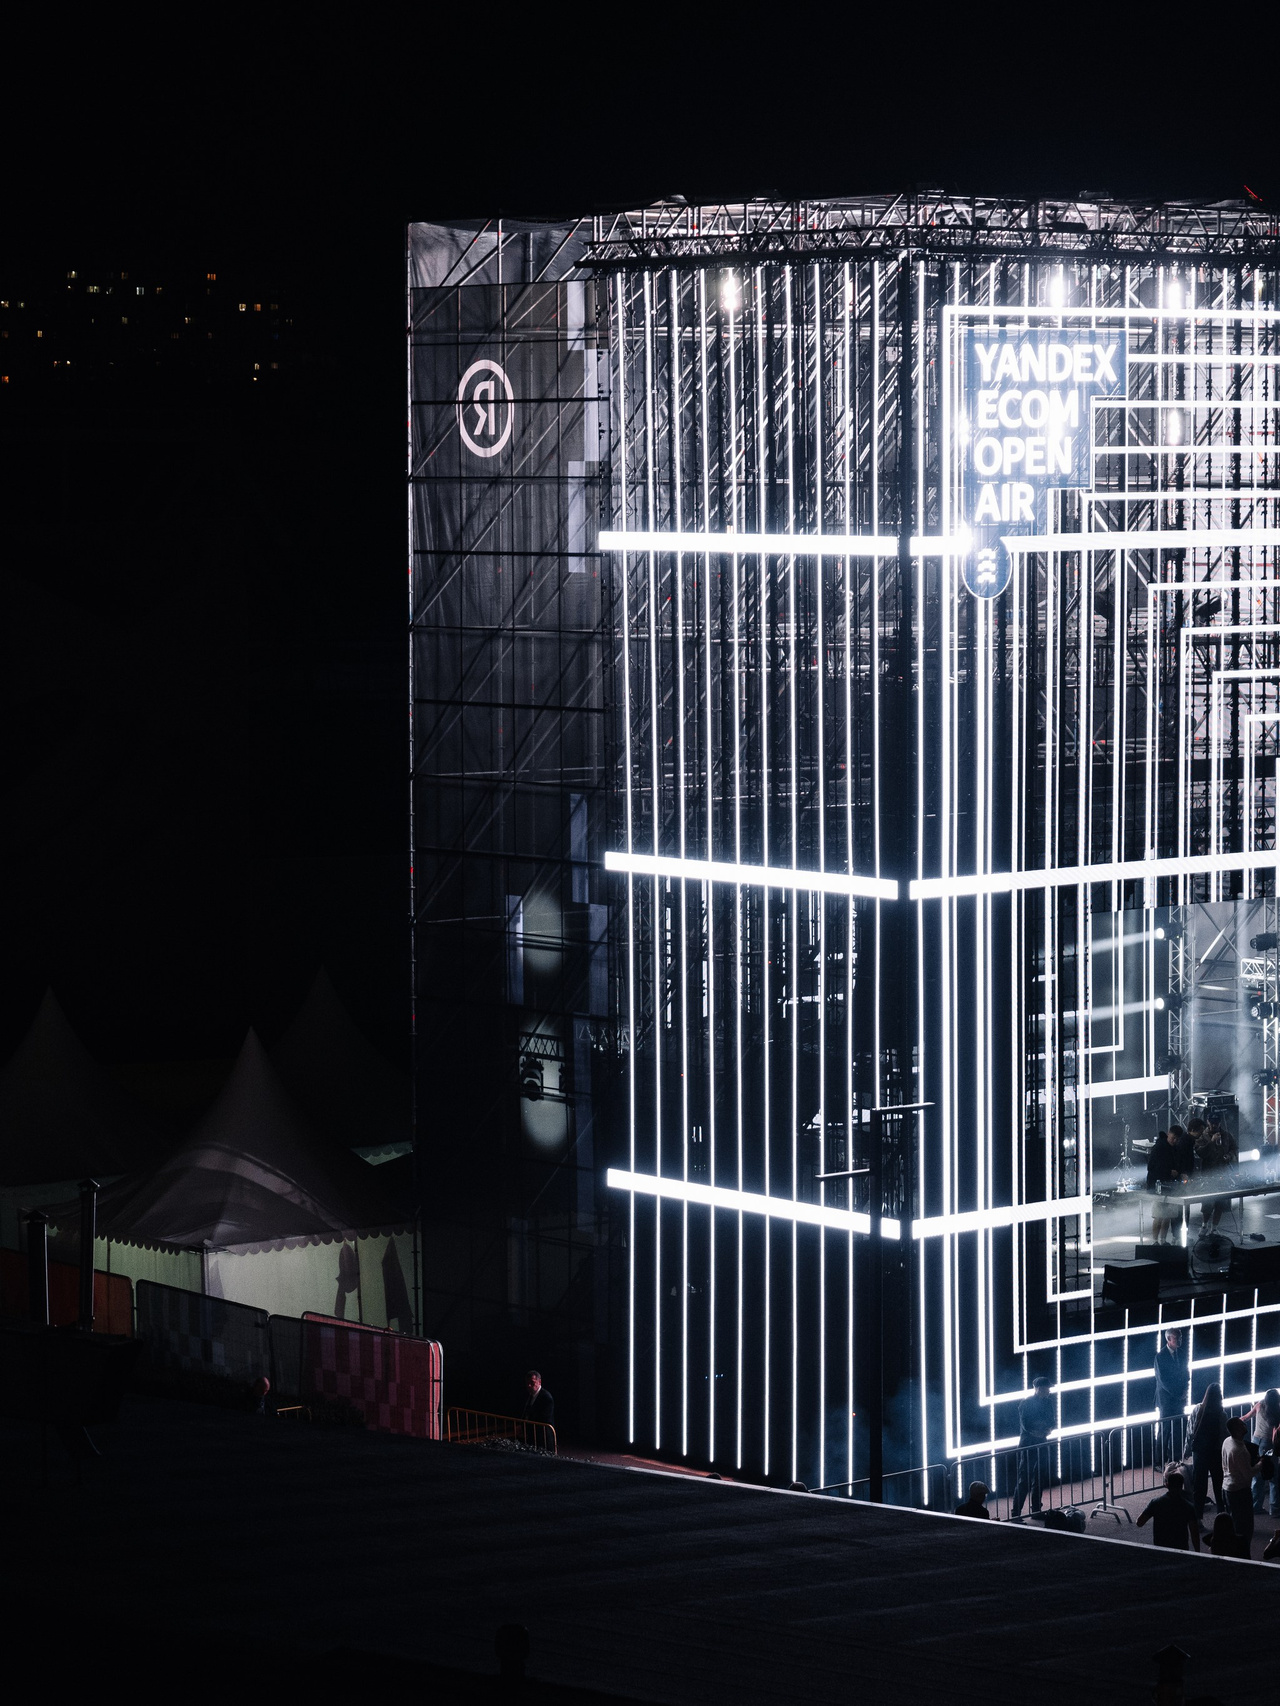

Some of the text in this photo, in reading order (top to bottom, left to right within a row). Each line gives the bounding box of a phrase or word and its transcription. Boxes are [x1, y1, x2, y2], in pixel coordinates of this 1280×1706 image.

[974, 343, 1118, 382] YANDEX
[977, 389, 1079, 429] ECOM
[974, 436, 1072, 476] OPEN
[974, 483, 1035, 522] AIR
